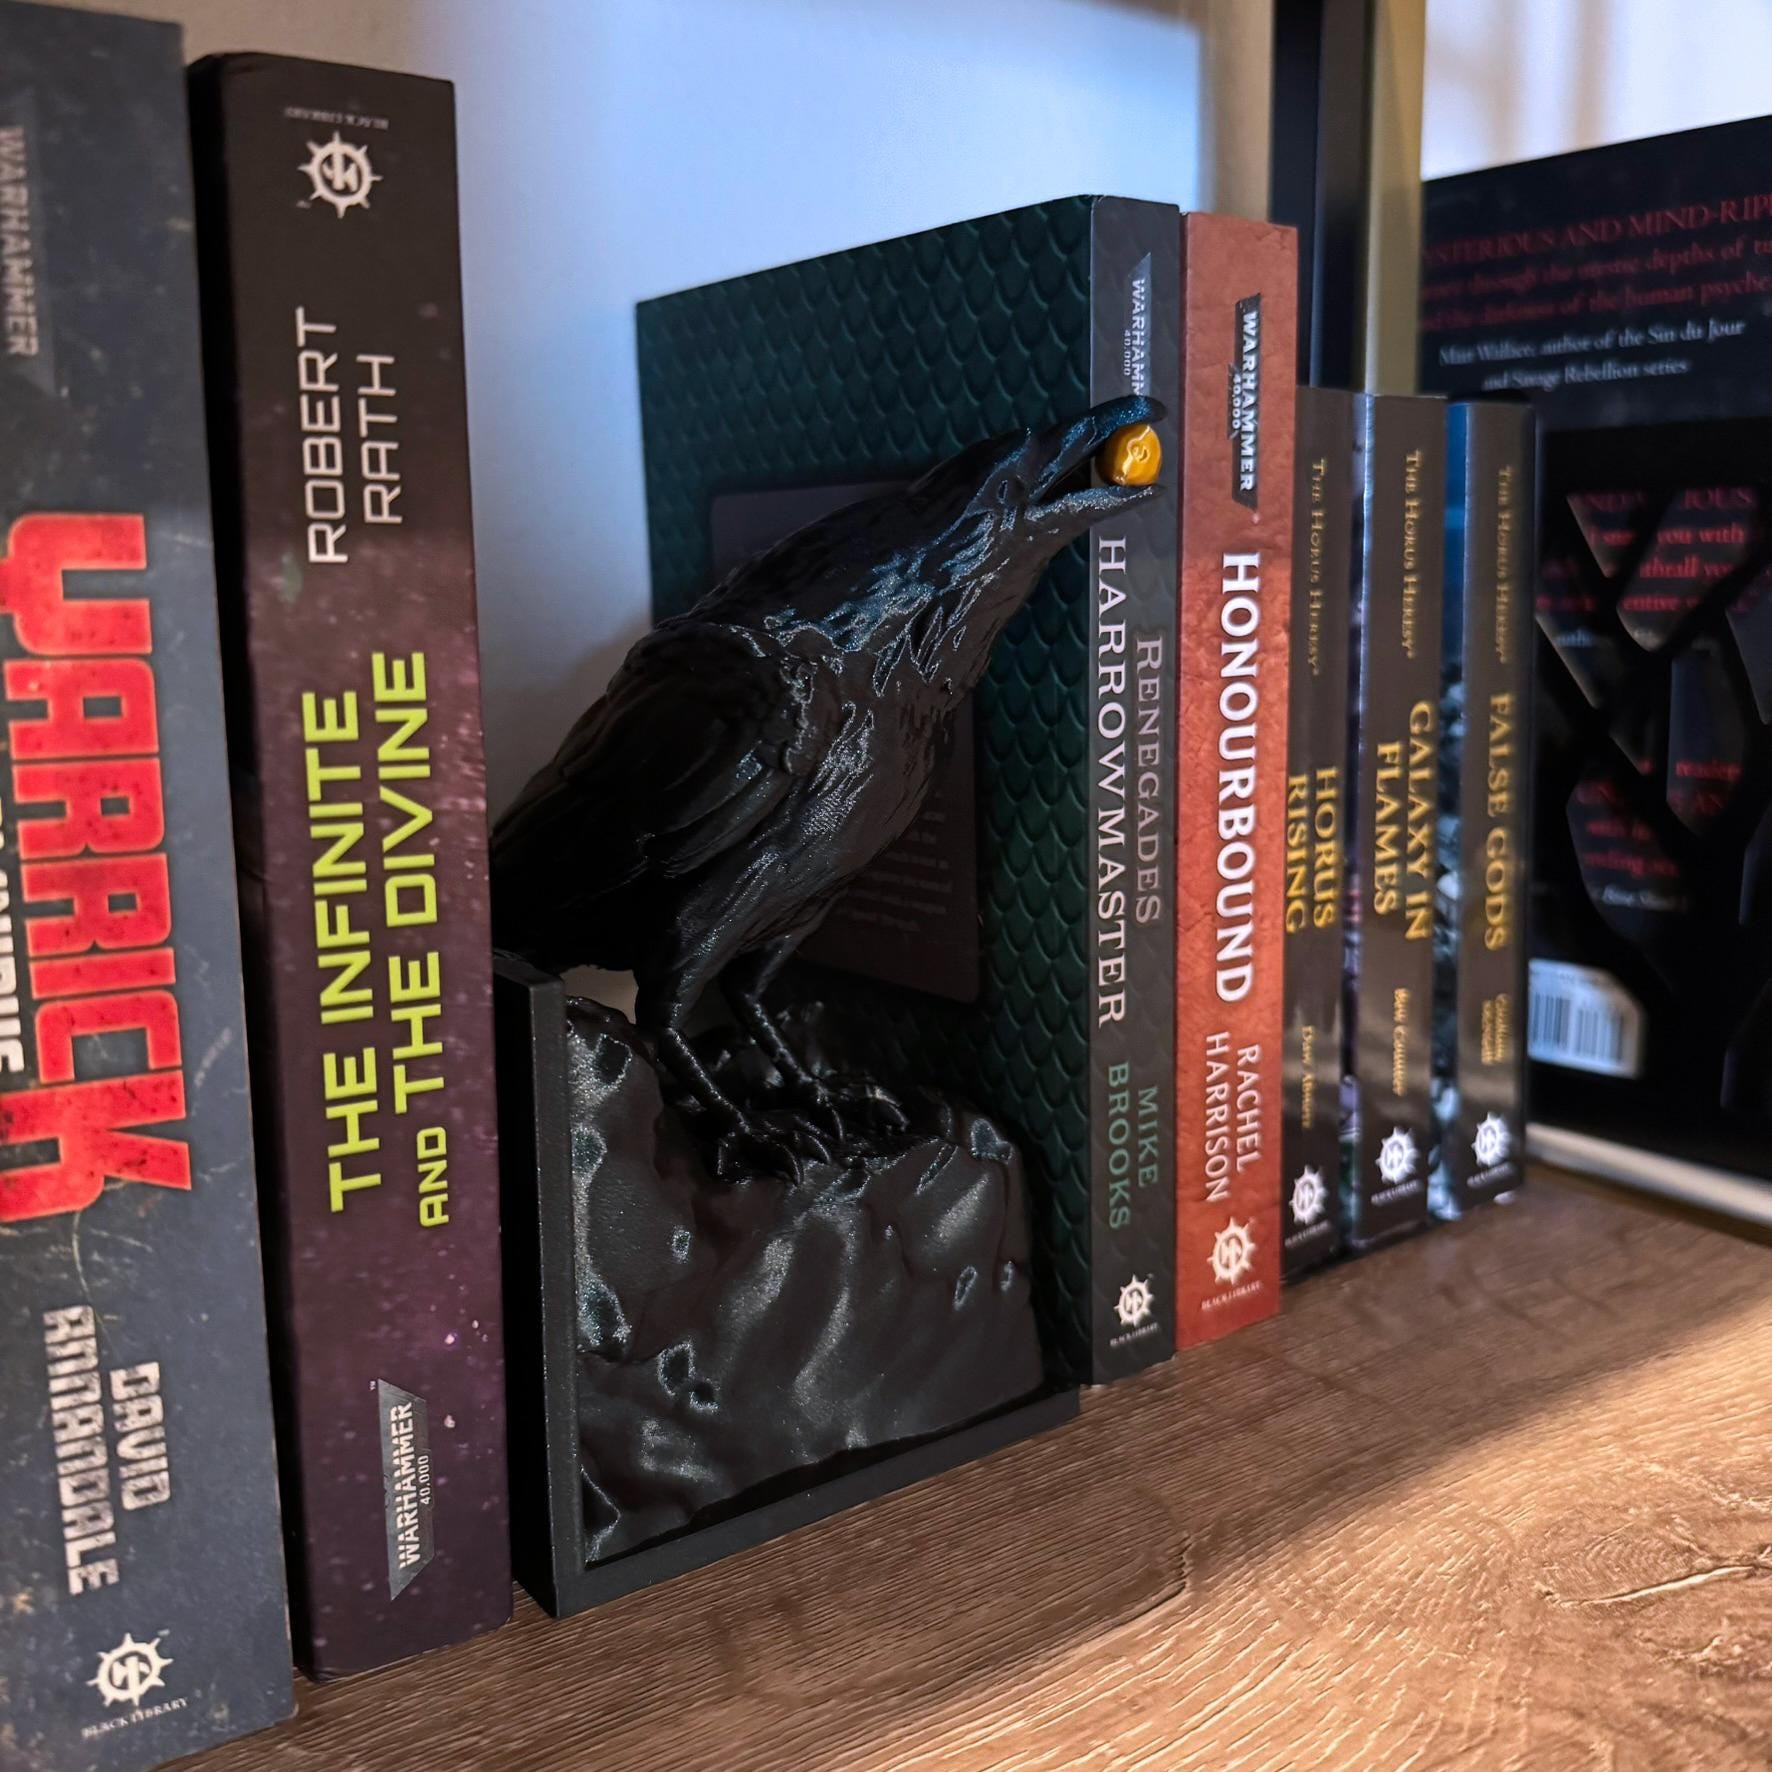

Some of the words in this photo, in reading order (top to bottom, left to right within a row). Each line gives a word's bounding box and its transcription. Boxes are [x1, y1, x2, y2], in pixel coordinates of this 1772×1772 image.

[0, 126, 38, 357] WARHAMMER
[1566, 219, 1622, 247] AND
[1628, 193, 1772, 237] MIND-RIP
[1131, 278, 1146, 396] WARHAMM
[1232, 373, 1242, 431] 40,000
[1239, 310, 1259, 492] WARHAMMER
[1564, 360, 1638, 385] Rebellion
[1594, 330, 1615, 350] of
[1618, 327, 1644, 348] the
[295, 306, 349, 563] ROBERT
[356, 354, 403, 524] RATH
[372, 652, 438, 926] DIVINE
[1098, 536, 1127, 1029] HARROWMASTER
[1136, 634, 1163, 925] RENEGADES
[1216, 551, 1260, 1003] HONOURBOUND
[1374, 741, 1402, 915] FLAMES
[1406, 701, 1434, 879] GALAXY
[1488, 692, 1512, 818] FALSE
[0, 513, 192, 1221] YARRICK
[302, 691, 374, 1025] INFINITE
[1286, 774, 1309, 934] RISING
[1313, 766, 1338, 929] HORUS
[1405, 891, 1430, 941] IN
[1484, 827, 1508, 951] GODS
[388, 952, 444, 1114] THE
[1236, 1043, 1262, 1173] RACHEL
[322, 1047, 382, 1212] THE
[416, 1126, 449, 1227] AND
[1108, 1059, 1131, 1231] BROOKS
[1138, 1085, 1159, 1189] MIKE
[1205, 1031, 1231, 1203] HARRISON
[43, 1305, 120, 1596] ANNANDALE
[109, 1361, 171, 1511] DAVID
[389, 1400, 420, 1569] WARHAMMER
[80, 1715, 129, 1739] BLACK
[130, 1697, 188, 1724] LIBRARY
